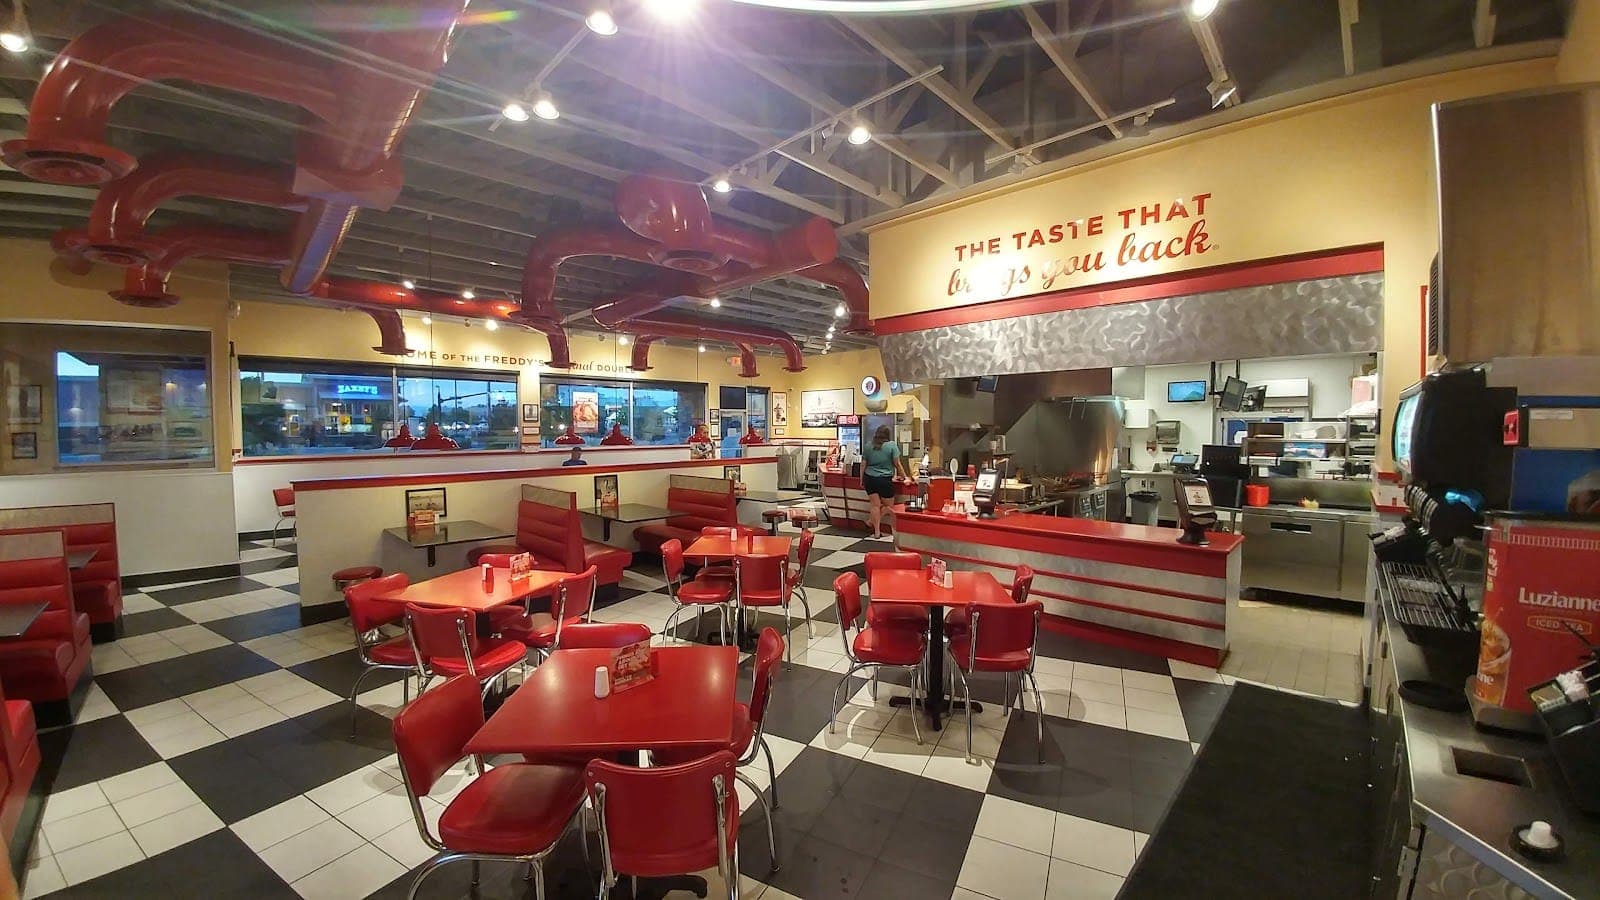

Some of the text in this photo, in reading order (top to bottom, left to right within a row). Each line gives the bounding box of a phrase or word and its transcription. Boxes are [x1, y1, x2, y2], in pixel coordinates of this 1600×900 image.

[955, 193, 1212, 262] THE TASTE THAT
[947, 218, 1212, 296] brgs you back
[395, 350, 437, 359] OME
[460, 354, 481, 362] THE
[484, 355, 545, 366] FREDDY'S
[1519, 587, 1600, 612] Luzianne
[1536, 619, 1560, 630] ICED
